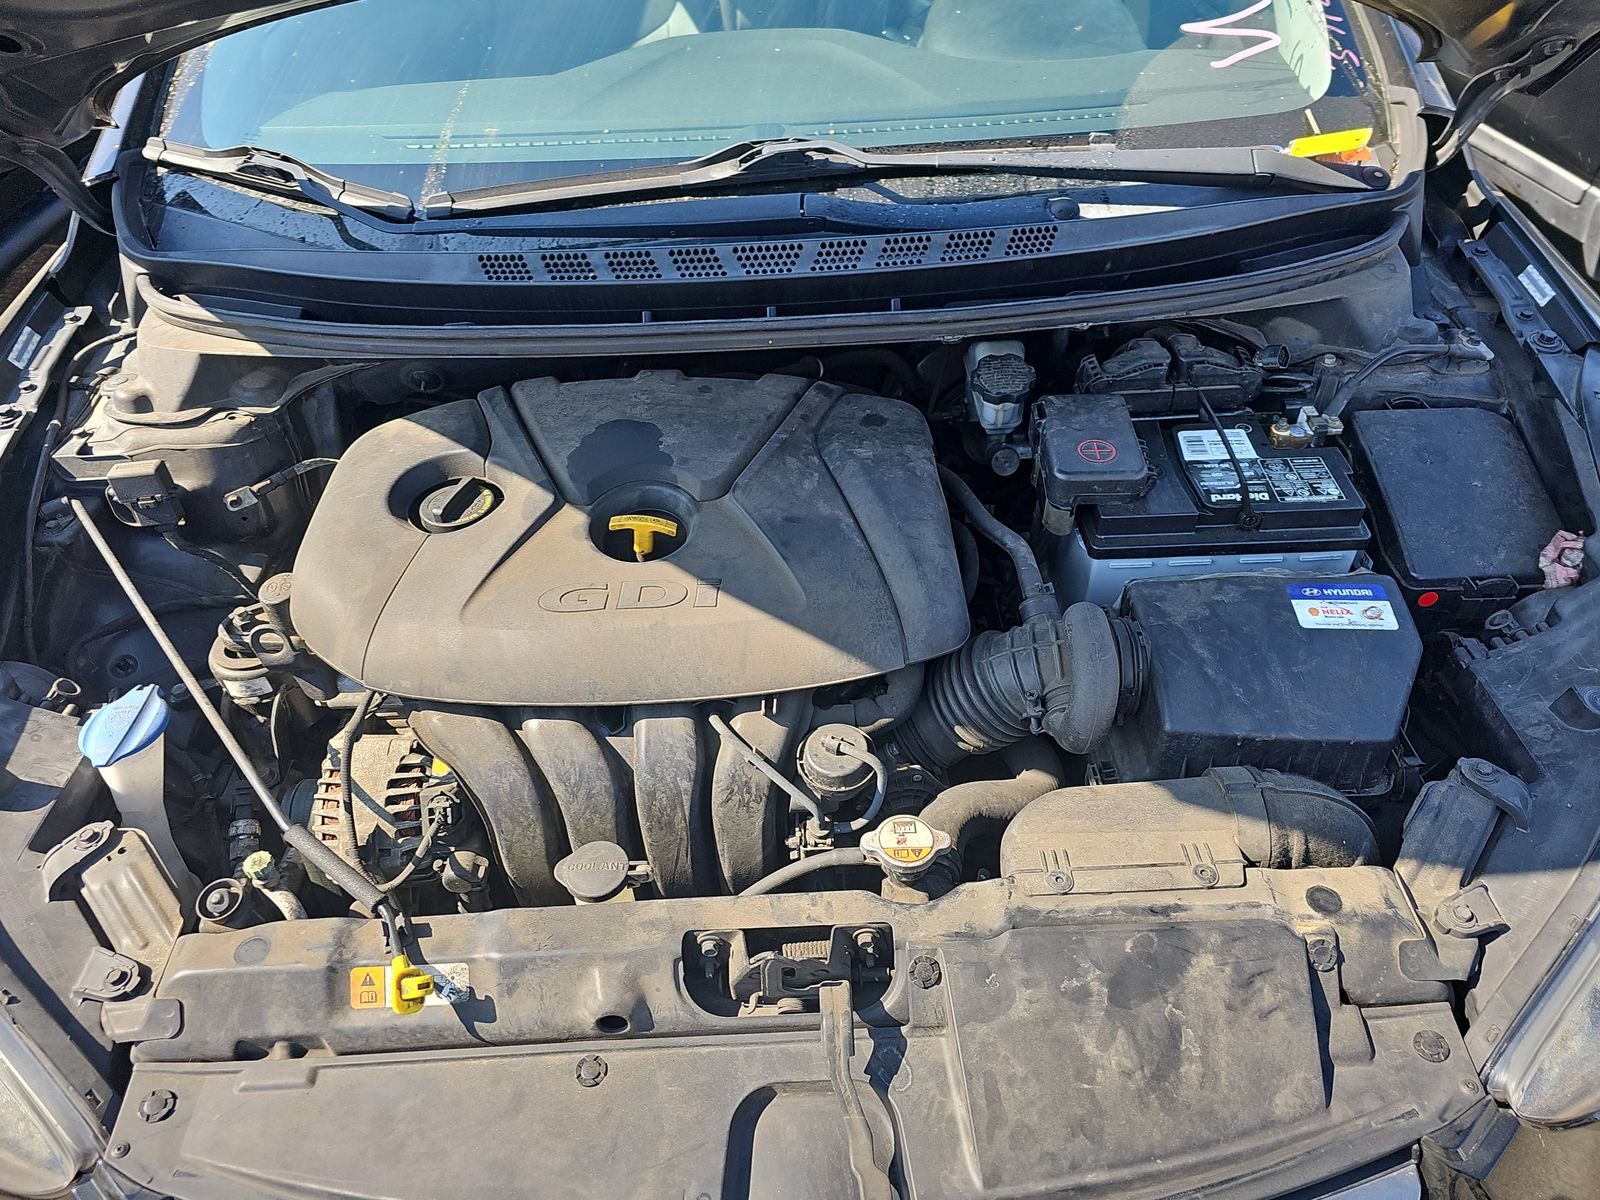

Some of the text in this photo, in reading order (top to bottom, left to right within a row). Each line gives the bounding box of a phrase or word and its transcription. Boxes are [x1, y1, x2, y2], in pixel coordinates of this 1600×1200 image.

[537, 578, 722, 613] GDi
[1323, 588, 1373, 597] HYUNDAI
[1321, 608, 1354, 616] HELIX
[567, 861, 628, 872] COOLANT
